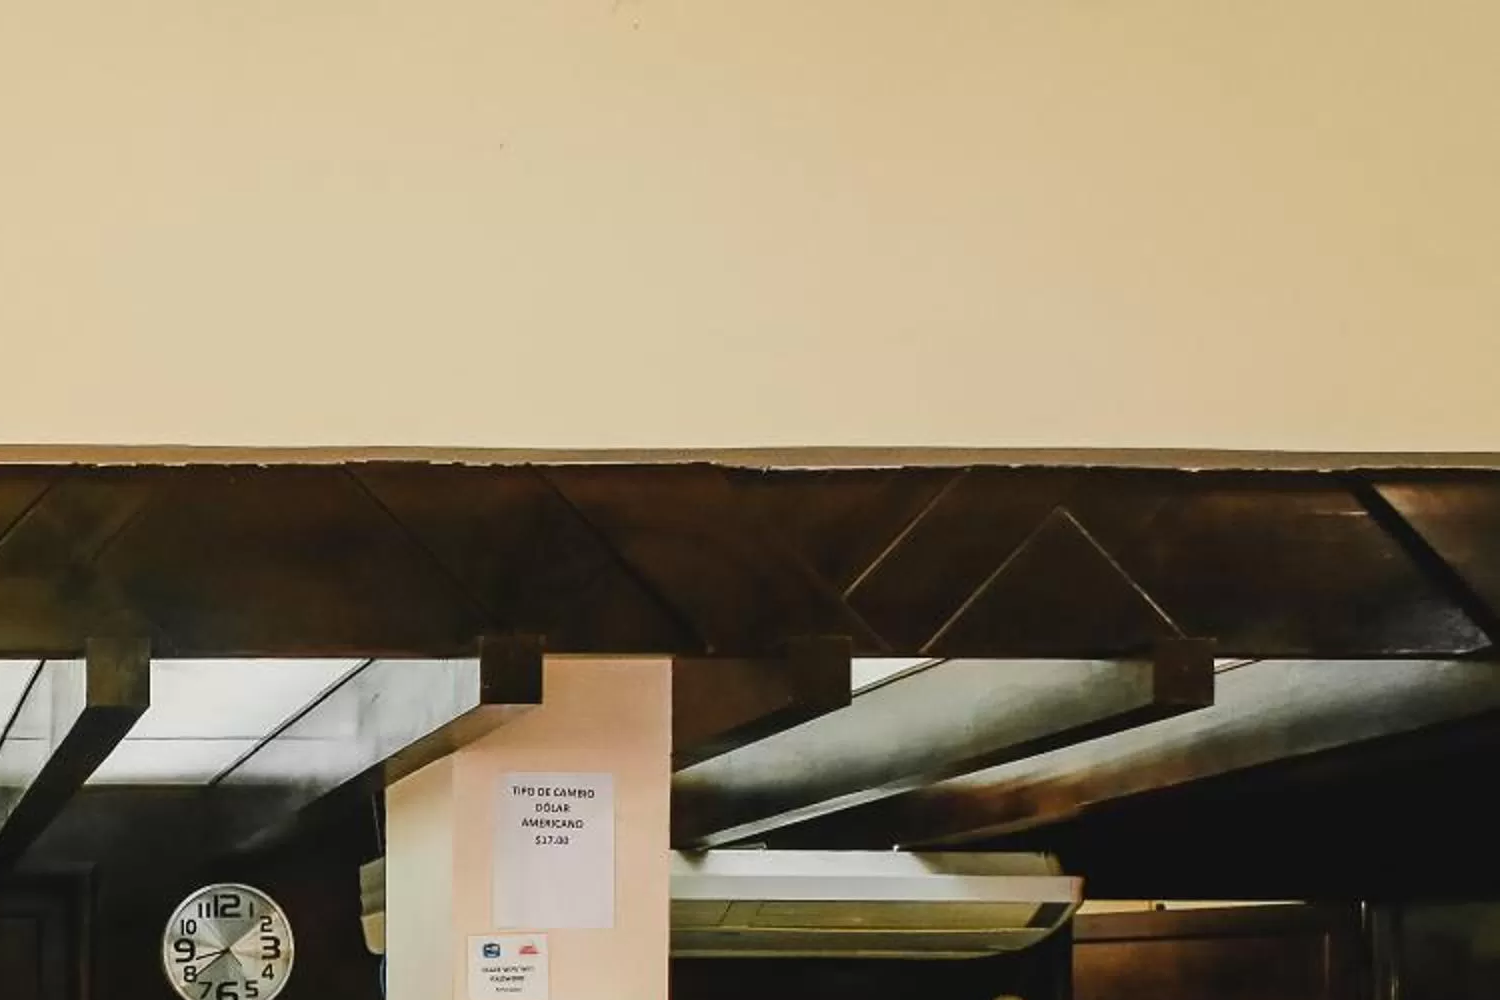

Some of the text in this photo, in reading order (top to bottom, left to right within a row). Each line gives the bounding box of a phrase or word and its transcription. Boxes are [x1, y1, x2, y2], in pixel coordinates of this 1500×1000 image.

[512, 785, 595, 799] TIPO DE CAMBIO
[535, 801, 571, 813] DÓLAR
[520, 817, 585, 829] AMERICANO
[198, 903, 211, 918] 11
[214, 894, 241, 918] 12
[180, 919, 197, 935] 10
[260, 916, 272, 932] 2
[174, 938, 195, 963] 9
[260, 936, 281, 960] 3
[183, 966, 197, 983] 8
[262, 963, 274, 980] 4
[198, 982, 212, 999] 7
[245, 980, 258, 998] 5
